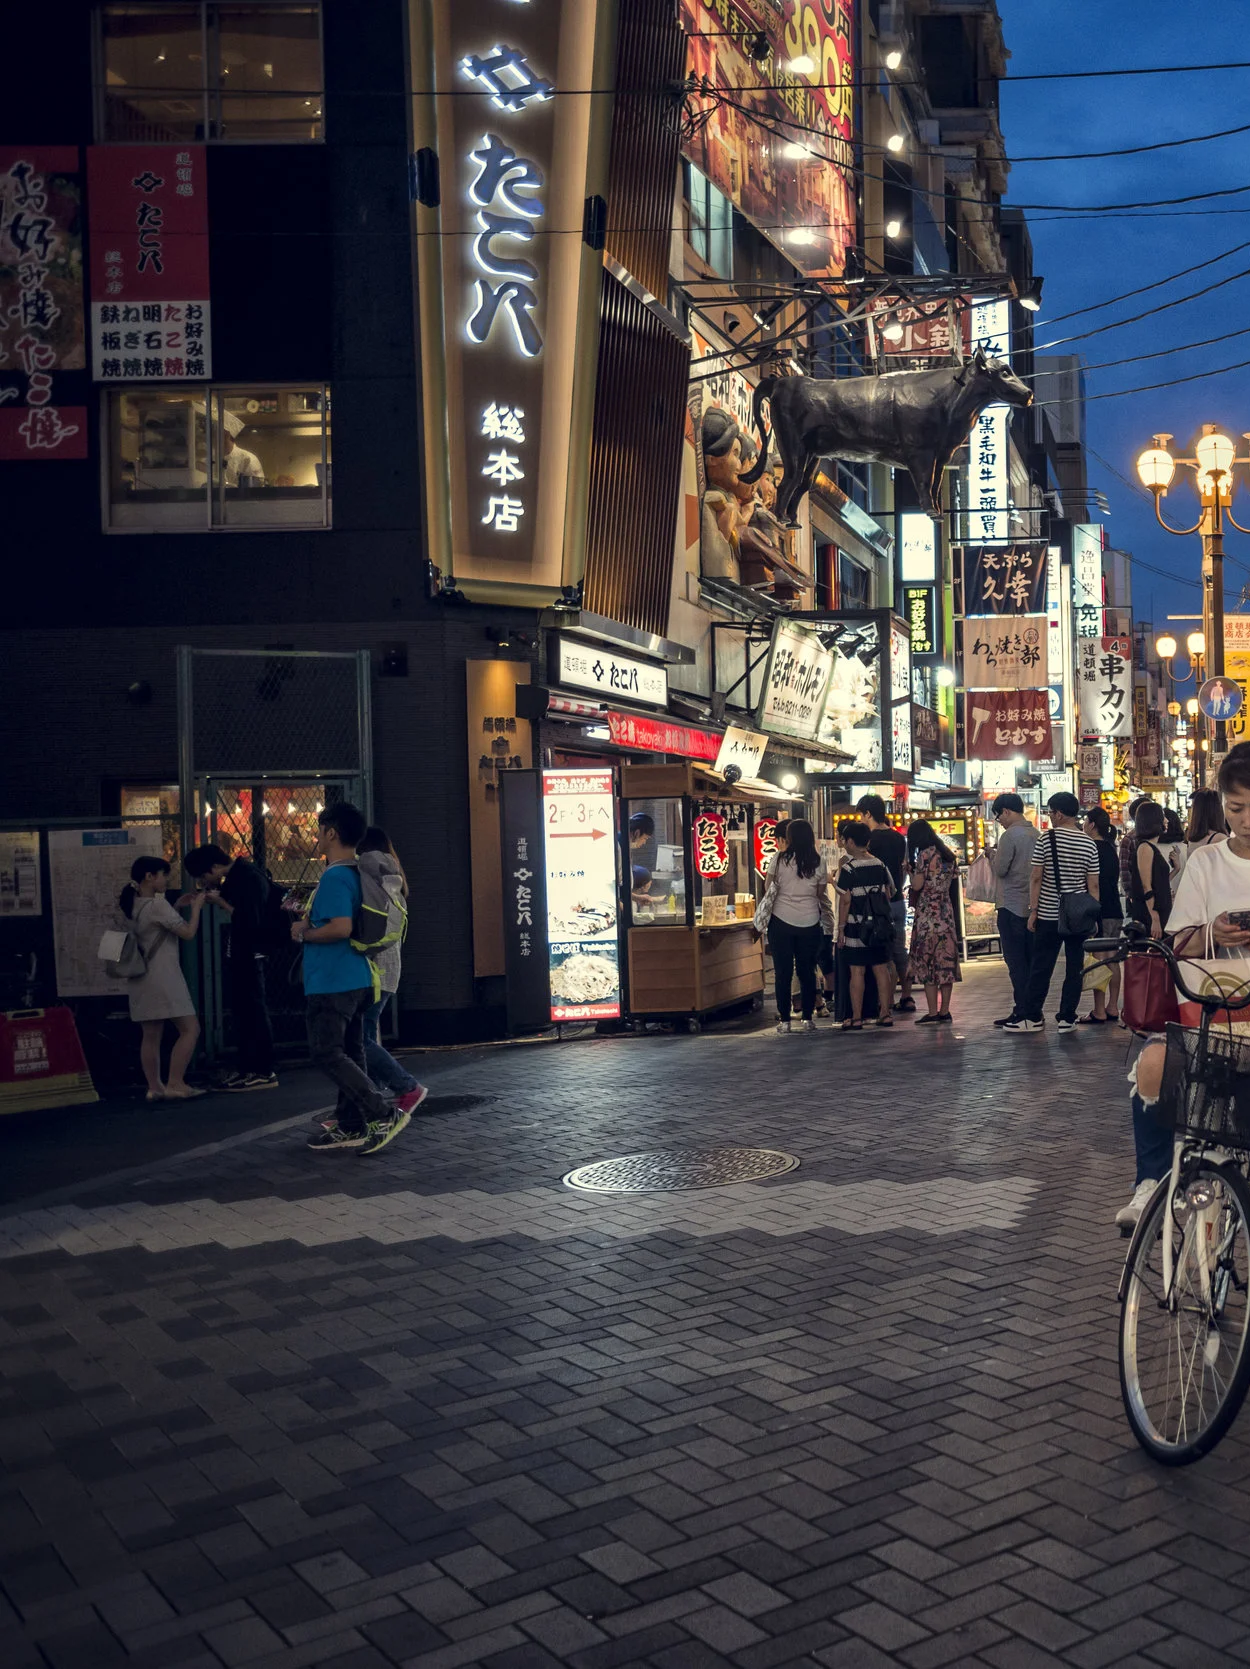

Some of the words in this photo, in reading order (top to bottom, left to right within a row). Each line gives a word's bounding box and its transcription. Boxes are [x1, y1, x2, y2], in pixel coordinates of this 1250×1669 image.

[466, 133, 547, 358] たこ八
[100, 304, 122, 379] 鉄板焼
[122, 305, 143, 378] ねぎ焼
[143, 304, 163, 378] 明石焼
[164, 304, 184, 378] たこ焼
[184, 303, 205, 378] お好み焼
[481, 402, 526, 534] 総本店
[982, 552, 1033, 570] 天ぷら
[982, 570, 1032, 608] 久幸
[1083, 643, 1097, 682] 道頓堀
[1098, 653, 1126, 734] 串カツ
[995, 708, 1047, 722] お好み焼
[697, 818, 722, 873] たこ焼
